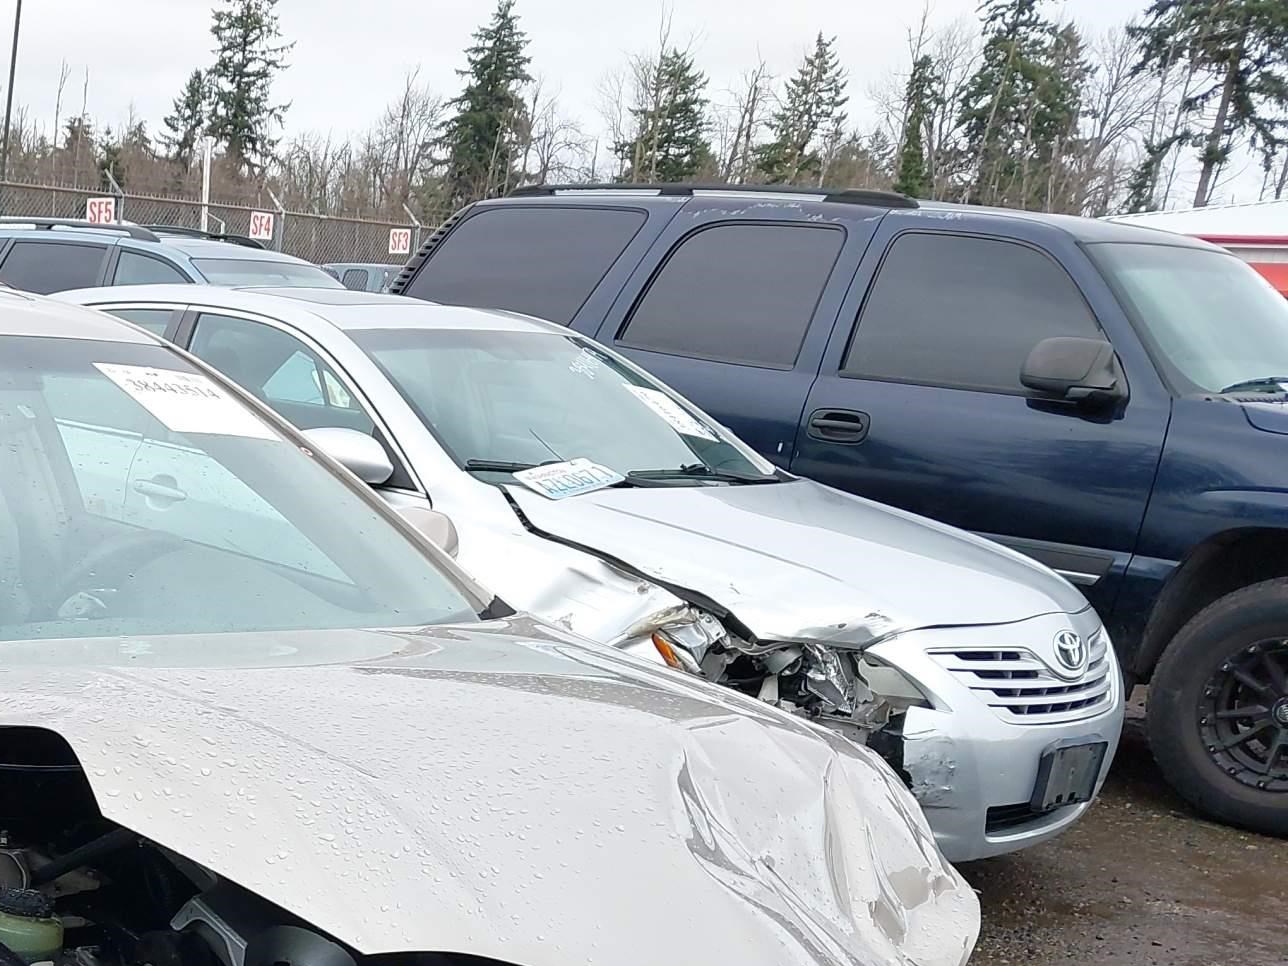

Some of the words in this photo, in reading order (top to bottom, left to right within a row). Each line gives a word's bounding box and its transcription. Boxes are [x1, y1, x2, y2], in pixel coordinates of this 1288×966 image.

[89, 201, 113, 223] SF5
[252, 214, 271, 236] SF4
[391, 231, 409, 250] SF3
[125, 377, 222, 400] 38443514
